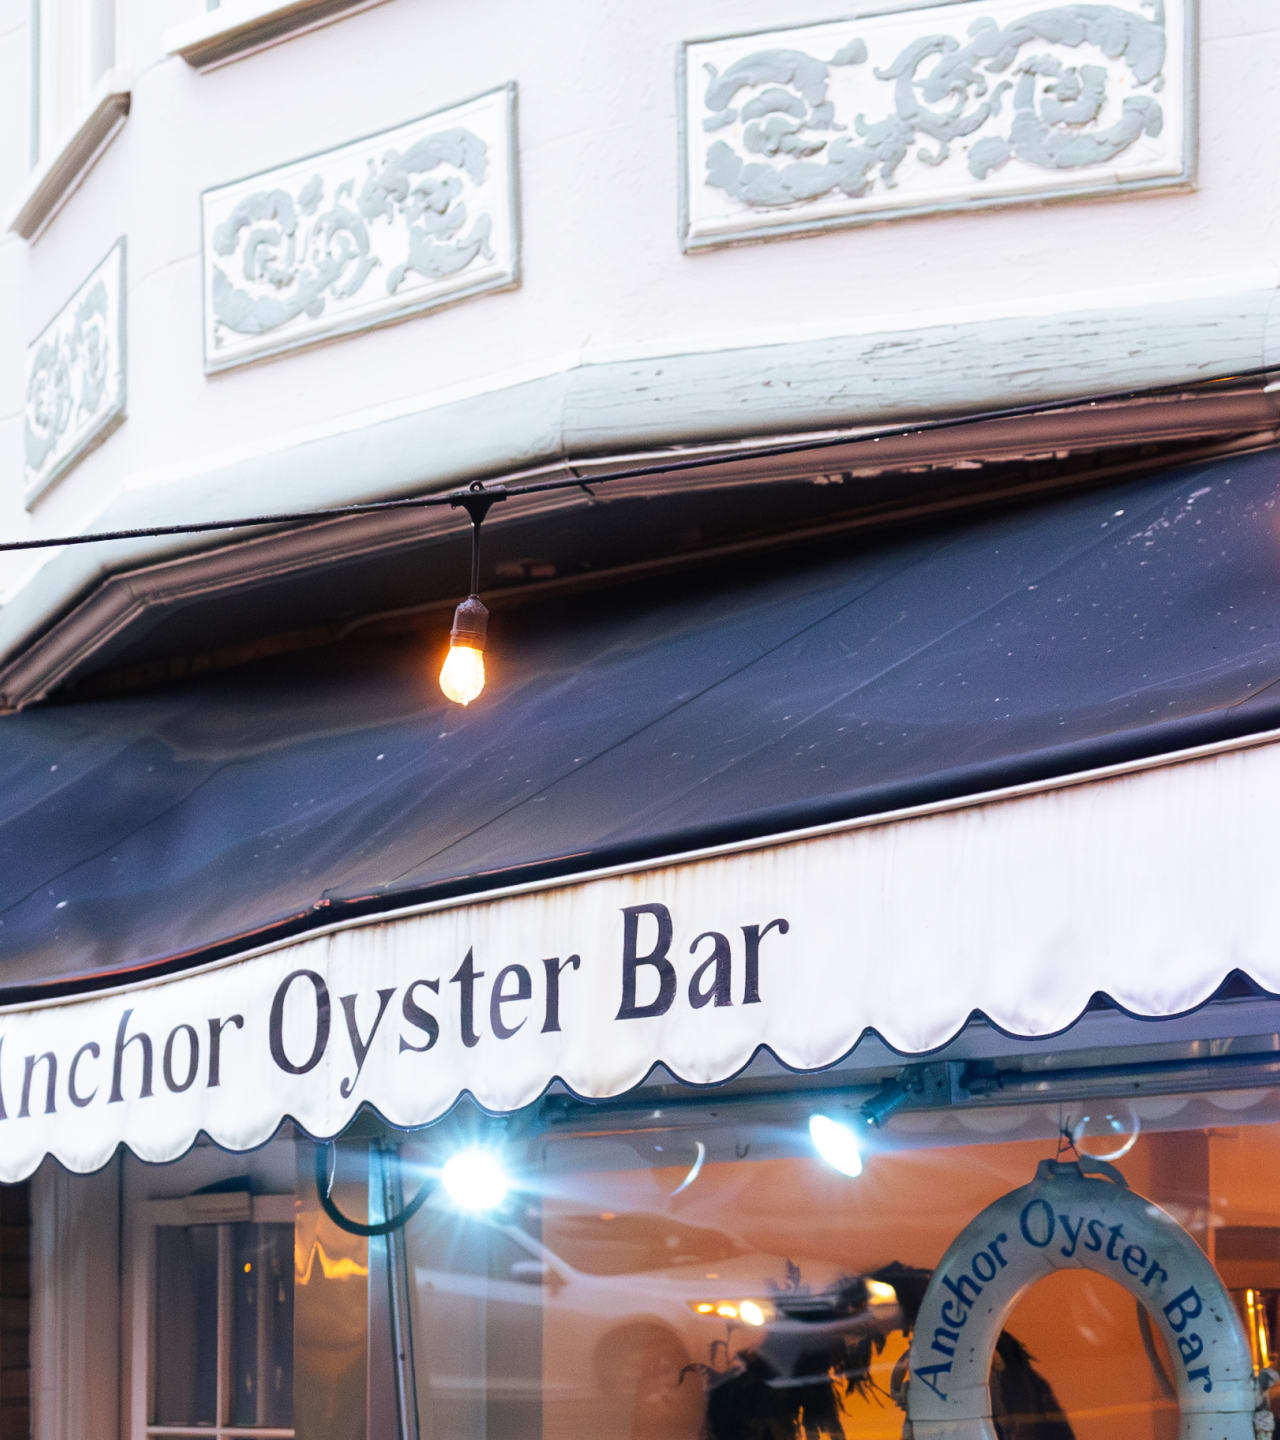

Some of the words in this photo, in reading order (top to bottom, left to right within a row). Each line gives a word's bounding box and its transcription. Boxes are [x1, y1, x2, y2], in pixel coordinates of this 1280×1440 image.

[268, 945, 581, 1099] Oyster
[614, 902, 790, 1020] Bar
[914, 1232, 1009, 1401] Anchor
[1020, 1198, 1169, 1288] Oyster
[1163, 1285, 1214, 1394] Bar
